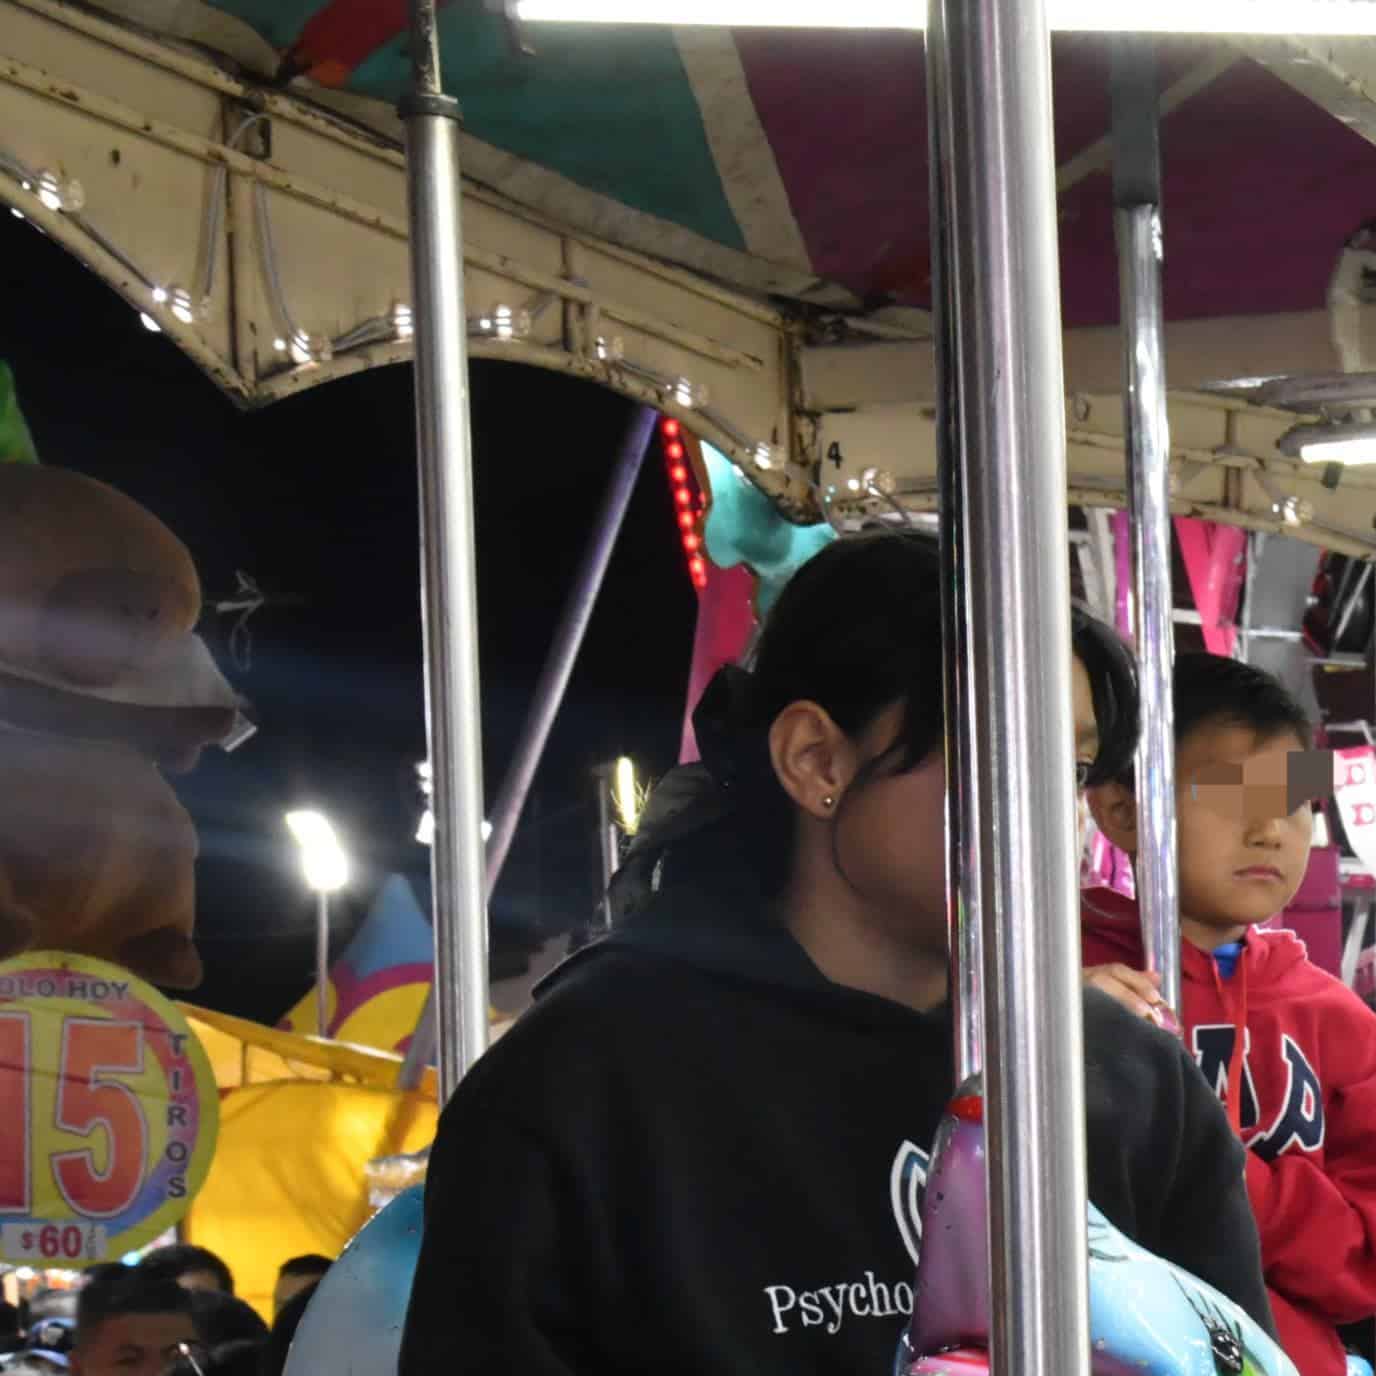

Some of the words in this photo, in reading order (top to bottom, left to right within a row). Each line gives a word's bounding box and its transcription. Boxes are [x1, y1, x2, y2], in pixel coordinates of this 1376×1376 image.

[827, 441, 843, 470] 4
[0, 979, 55, 997] OLO
[67, 981, 128, 1001] HOY
[0, 1012, 148, 1217] 15
[166, 1032, 188, 1199] TIROS
[1192, 1023, 1326, 1162] AP
[763, 1270, 914, 1335] Psycho
